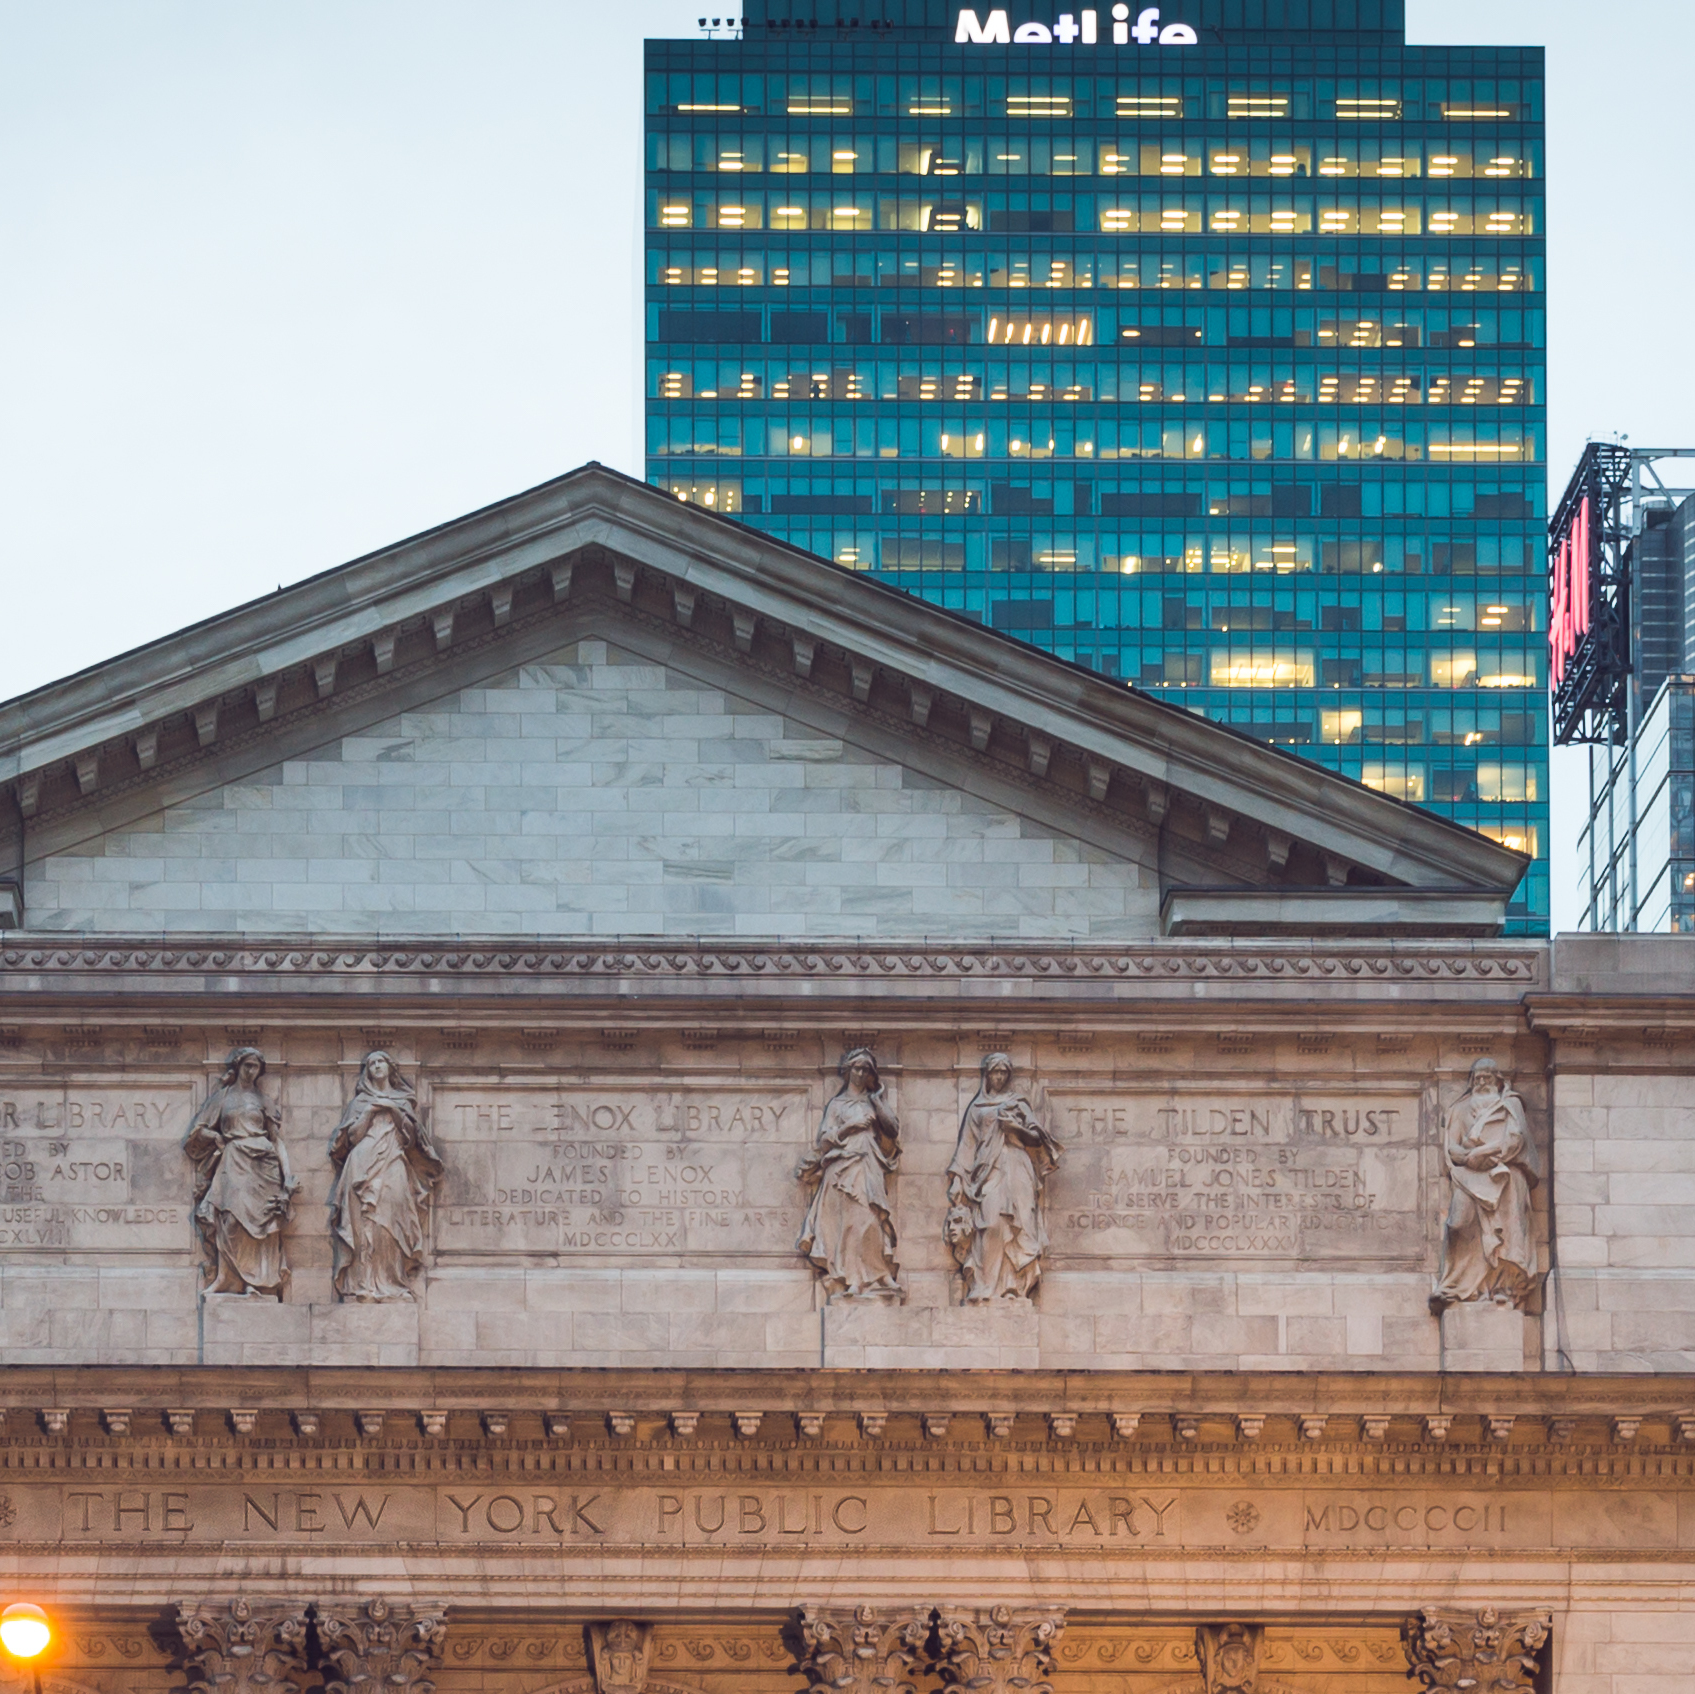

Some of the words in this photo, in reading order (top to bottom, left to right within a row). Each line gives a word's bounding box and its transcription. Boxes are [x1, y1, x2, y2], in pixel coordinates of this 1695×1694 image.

[955, 3, 1198, 45] MetLife
[34, 1101, 170, 1130] LIBRARY
[455, 1104, 515, 1131] THE
[532, 1104, 637, 1131] LENOX
[655, 1104, 788, 1132] LIBRARY
[1068, 1108, 1129, 1136] THE
[1157, 1108, 1271, 1136] TILDEN
[1298, 1109, 1400, 1136] TRUST
[49, 1142, 71, 1158] BY
[553, 1145, 643, 1160] FOUNDED
[665, 1145, 688, 1161] BY
[1167, 1148, 1257, 1163] FOUNDED
[1278, 1148, 1300, 1164] BY
[50, 1162, 126, 1182] ASTOR
[526, 1165, 609, 1184] JAMES
[630, 1165, 715, 1184] LENOX
[1105, 1168, 1193, 1188] SAMUEL
[1202, 1169, 1277, 1188] JONES
[1288, 1169, 1367, 1188] TILDEN
[7, 1186, 45, 1202] THE
[497, 1189, 603, 1204] DEDICATED
[618, 1189, 642, 1204] TO
[658, 1189, 744, 1206] HISTORY
[1125, 1193, 1180, 1209] SERVE
[1193, 1193, 1231, 1209] THE
[1240, 1193, 1342, 1210] INTERESTS
[1354, 1194, 1377, 1210] OF
[3, 1208, 65, 1224] USEFUL
[71, 1208, 179, 1224] KNOWLEDGE
[449, 1211, 572, 1226] LITERATURE
[587, 1211, 625, 1227] AND
[638, 1211, 676, 1227] THE
[688, 1211, 730, 1227] FINE
[742, 1211, 789, 1227] ARTS
[1067, 1214, 1146, 1229] SCIENCE
[1157, 1214, 1196, 1230] AND
[1205, 1214, 1289, 1229] POPULAR
[564, 1231, 679, 1247] MDCCCLXX
[68, 1492, 195, 1532] THE
[242, 1492, 390, 1532] NEW
[444, 1493, 606, 1535] YORK
[656, 1494, 870, 1535] PUBLIC
[927, 1496, 1179, 1537] LIBRARY
[1305, 1505, 1506, 1534] MDCCCCII
